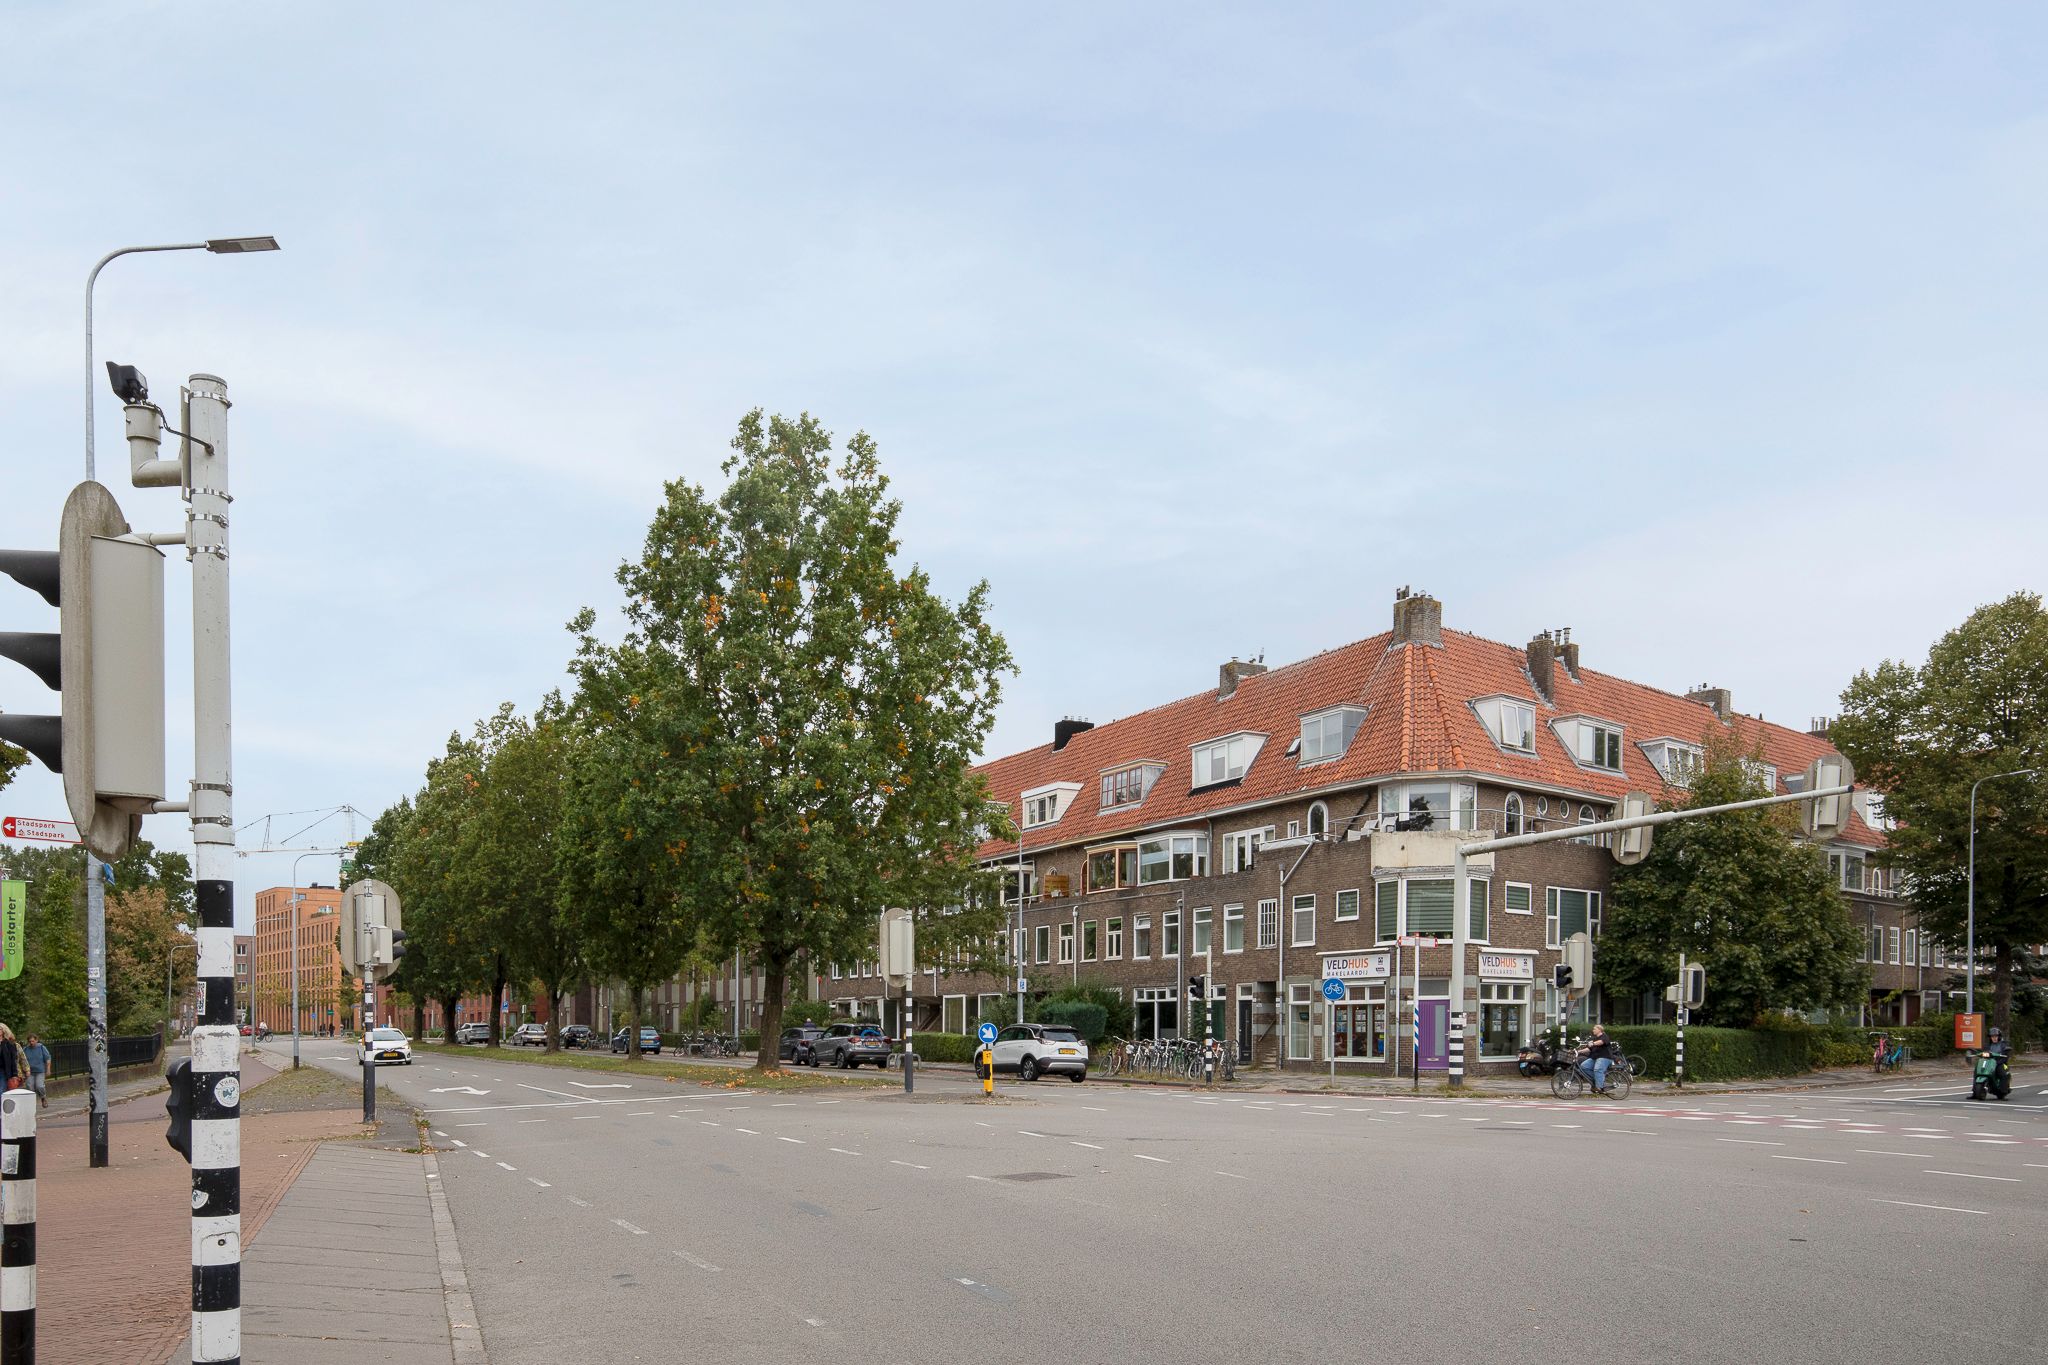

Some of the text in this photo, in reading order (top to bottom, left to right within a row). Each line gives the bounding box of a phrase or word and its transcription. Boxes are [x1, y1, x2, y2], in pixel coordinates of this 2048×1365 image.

[17, 819, 56, 829] Stadspark
[26, 829, 65, 838] Stadspark
[5, 897, 16, 955] destarter
[1326, 958, 1369, 970] VELDHUIS
[1482, 956, 1517, 968] VELDHUIS
